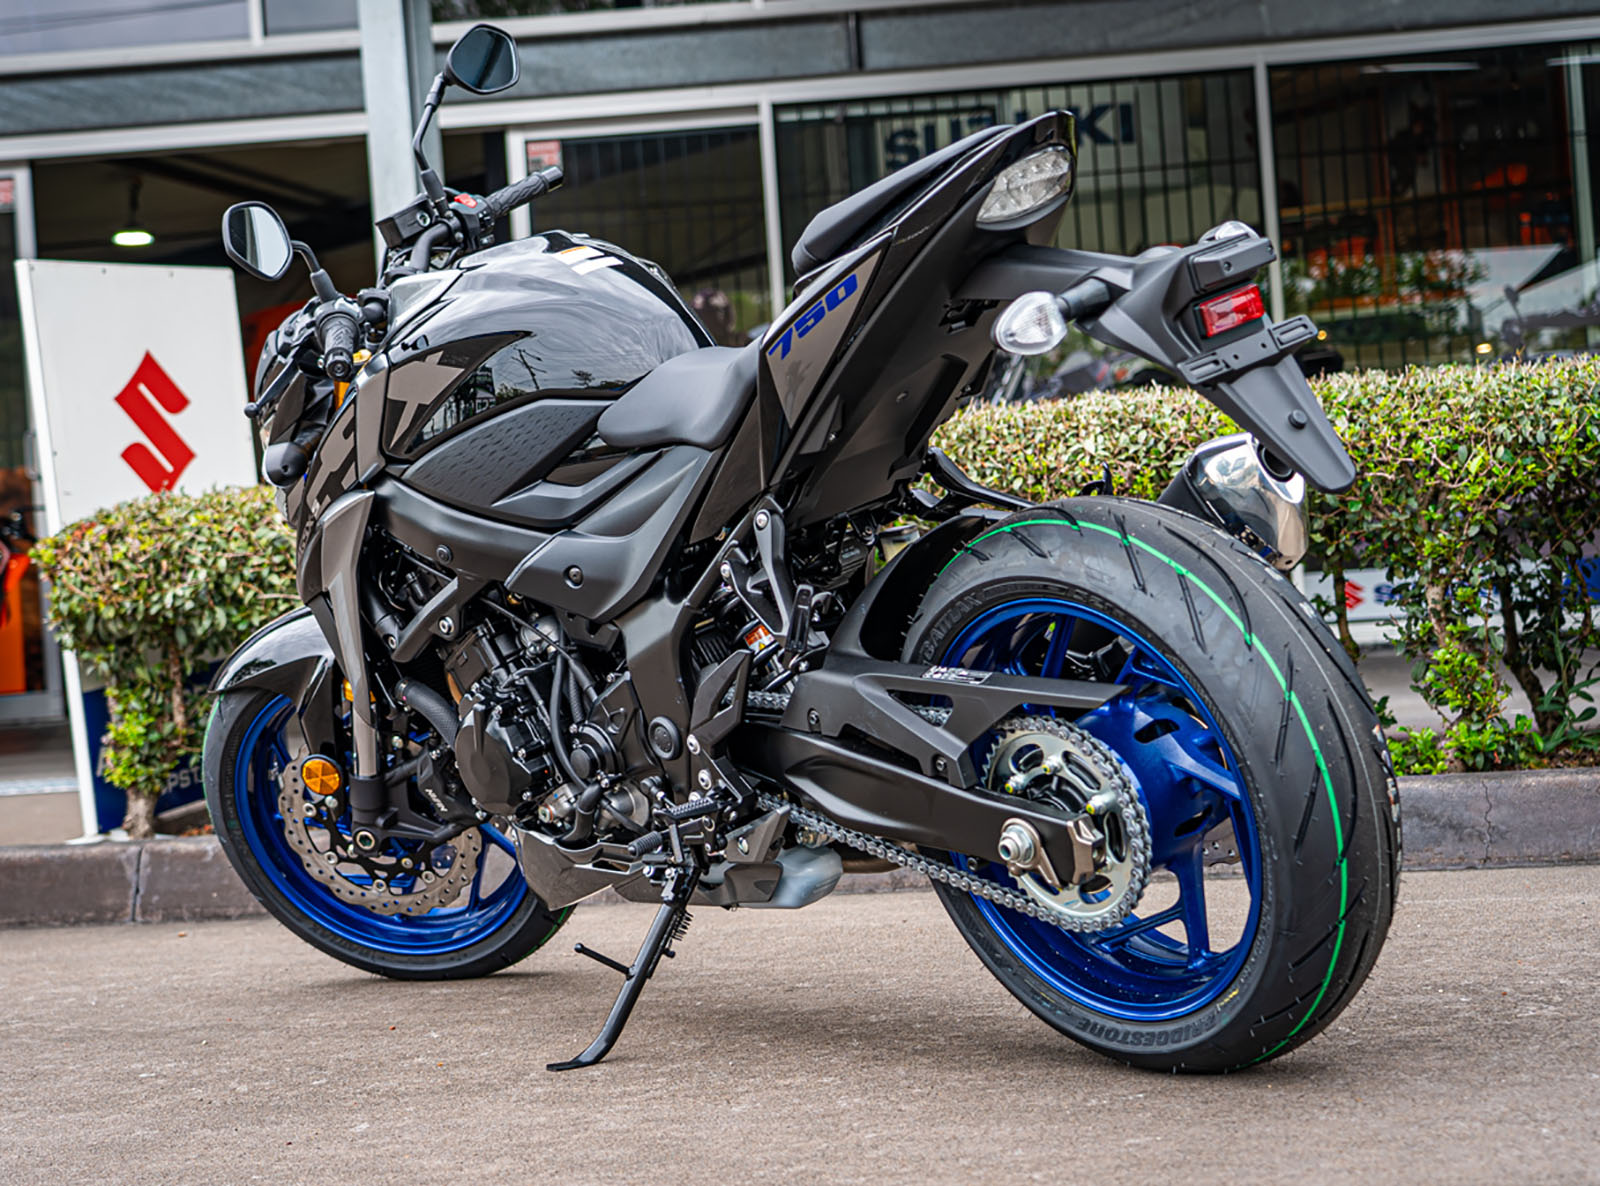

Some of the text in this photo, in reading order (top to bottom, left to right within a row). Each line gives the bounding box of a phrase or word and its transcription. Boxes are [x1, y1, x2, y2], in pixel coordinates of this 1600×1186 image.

[886, 102, 1135, 169] SUKI
[768, 273, 858, 361] 750
[1077, 1010, 1218, 1047] BRIDGESTONE
